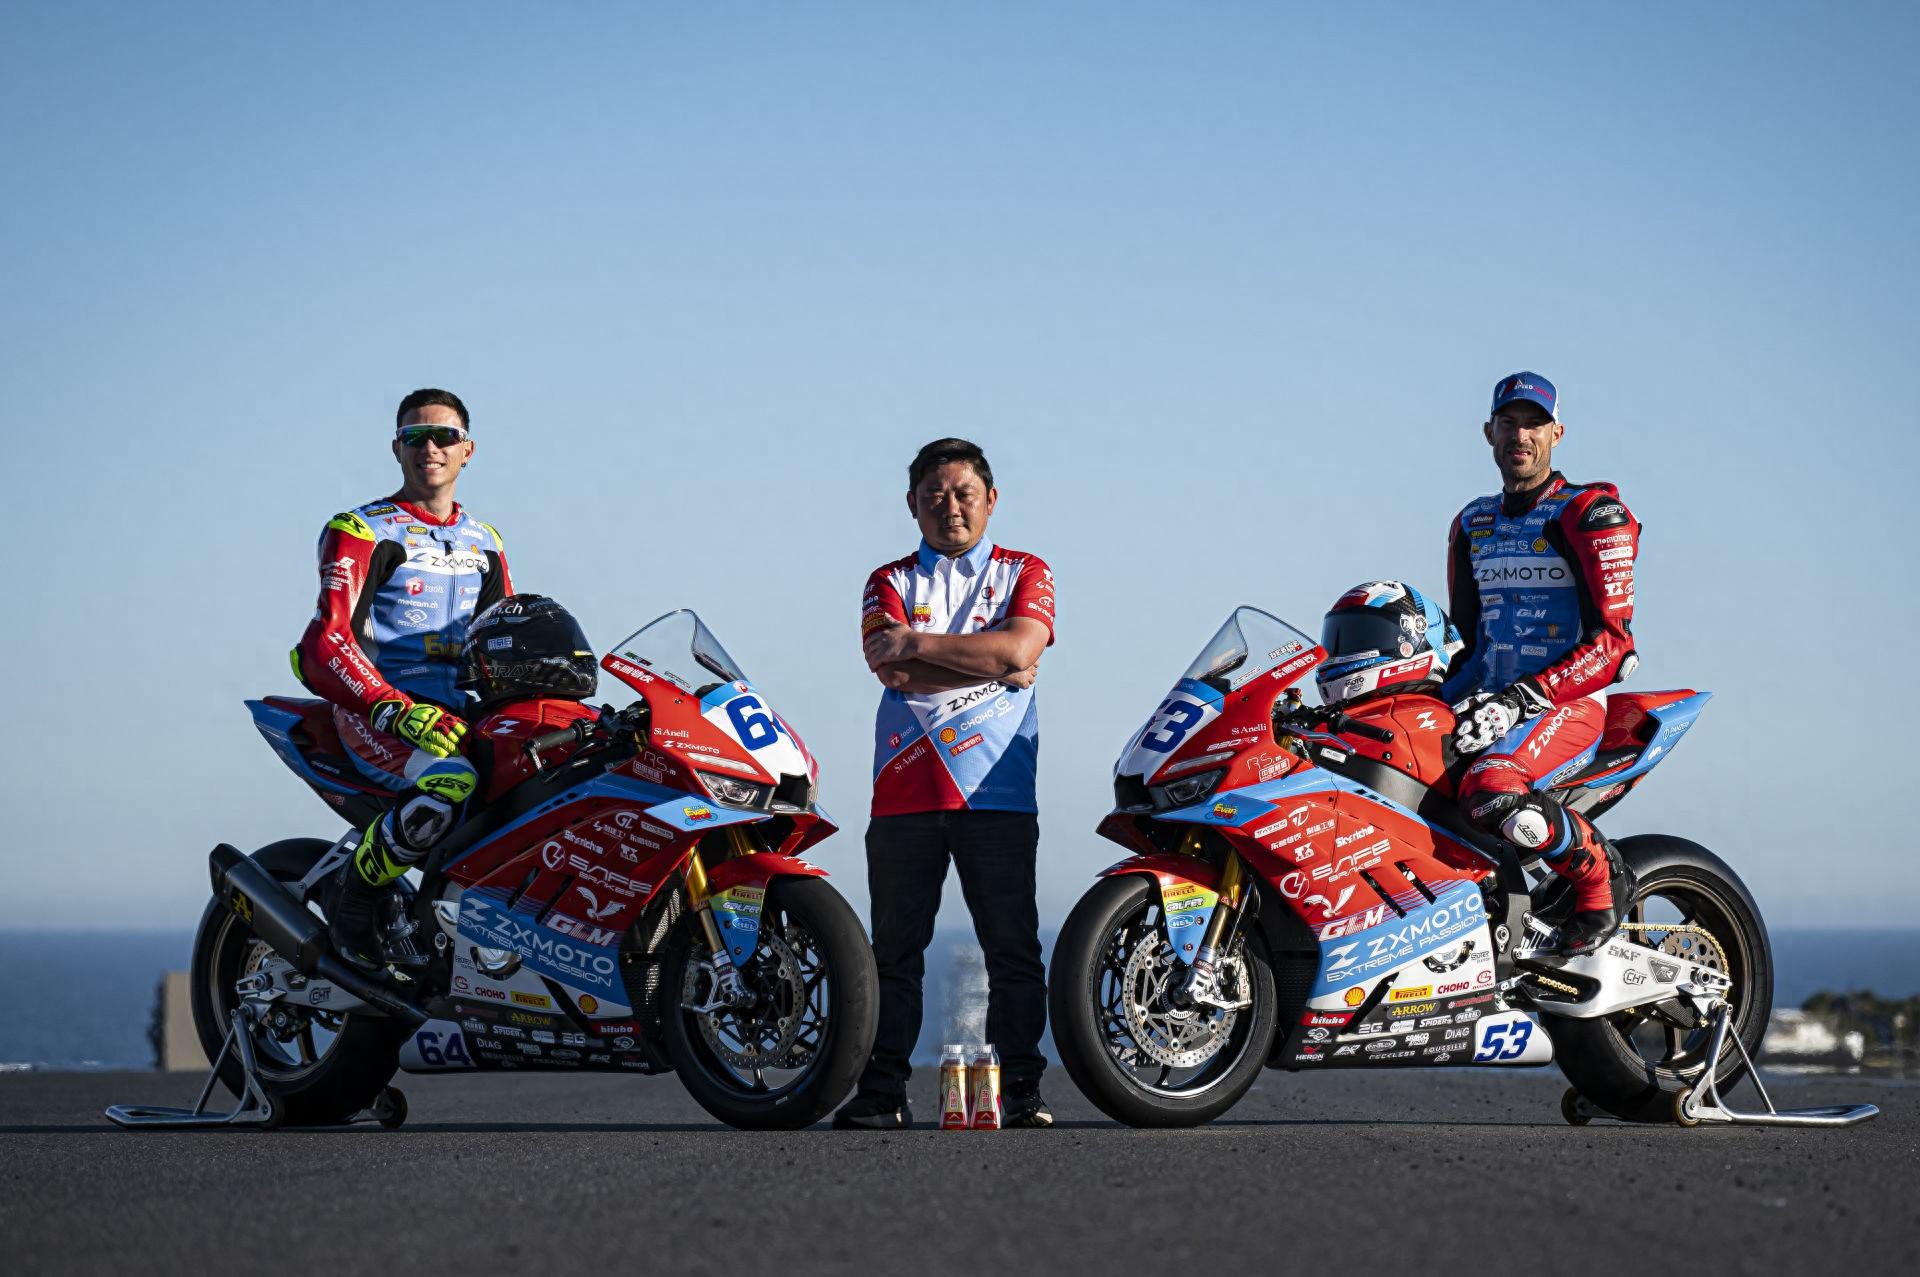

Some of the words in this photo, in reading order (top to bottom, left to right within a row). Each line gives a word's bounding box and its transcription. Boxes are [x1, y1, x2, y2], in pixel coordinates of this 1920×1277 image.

[1480, 567, 1565, 582] ZXMOTO
[340, 644, 382, 687] ZXMOTO
[1383, 658, 1430, 678] LS2
[1561, 644, 1603, 677] ZXMOTO
[947, 681, 1001, 712] ZXMO
[961, 709, 994, 731] CHOHO
[1141, 699, 1204, 753] 3
[1241, 723, 1267, 733] Anelli
[664, 729, 689, 738] Anelli
[677, 742, 720, 754] ZXMOTO
[1312, 839, 1391, 881] SAFE
[1328, 856, 1381, 882] BRAKES
[569, 854, 652, 894] SAFE
[547, 914, 616, 946] GLM
[1319, 905, 1385, 942] GLM
[1368, 893, 1482, 957] ZXMOTO
[460, 916, 533, 959] EXTREME
[538, 953, 612, 988] PASSION
[494, 913, 614, 974] ZXMOTO
[1326, 943, 1414, 982] EXTREME
[1420, 911, 1486, 948] PASSION
[1608, 945, 1640, 962] SKF
[1623, 968, 1647, 985] CHT
[475, 987, 506, 999] CHOHO
[1395, 987, 1428, 999] PIRELLI
[1437, 981, 1469, 994] CHOHO
[512, 1012, 551, 1025] ARROW
[1392, 1002, 1436, 1016] ARROW
[601, 1025, 633, 1033] bitubo
[1311, 1016, 1345, 1024] bitubo
[1419, 1015, 1450, 1028] SPIDER
[1445, 1027, 1470, 1040] DIAG
[1472, 1021, 1534, 1062] 53
[416, 1031, 471, 1066] 64
